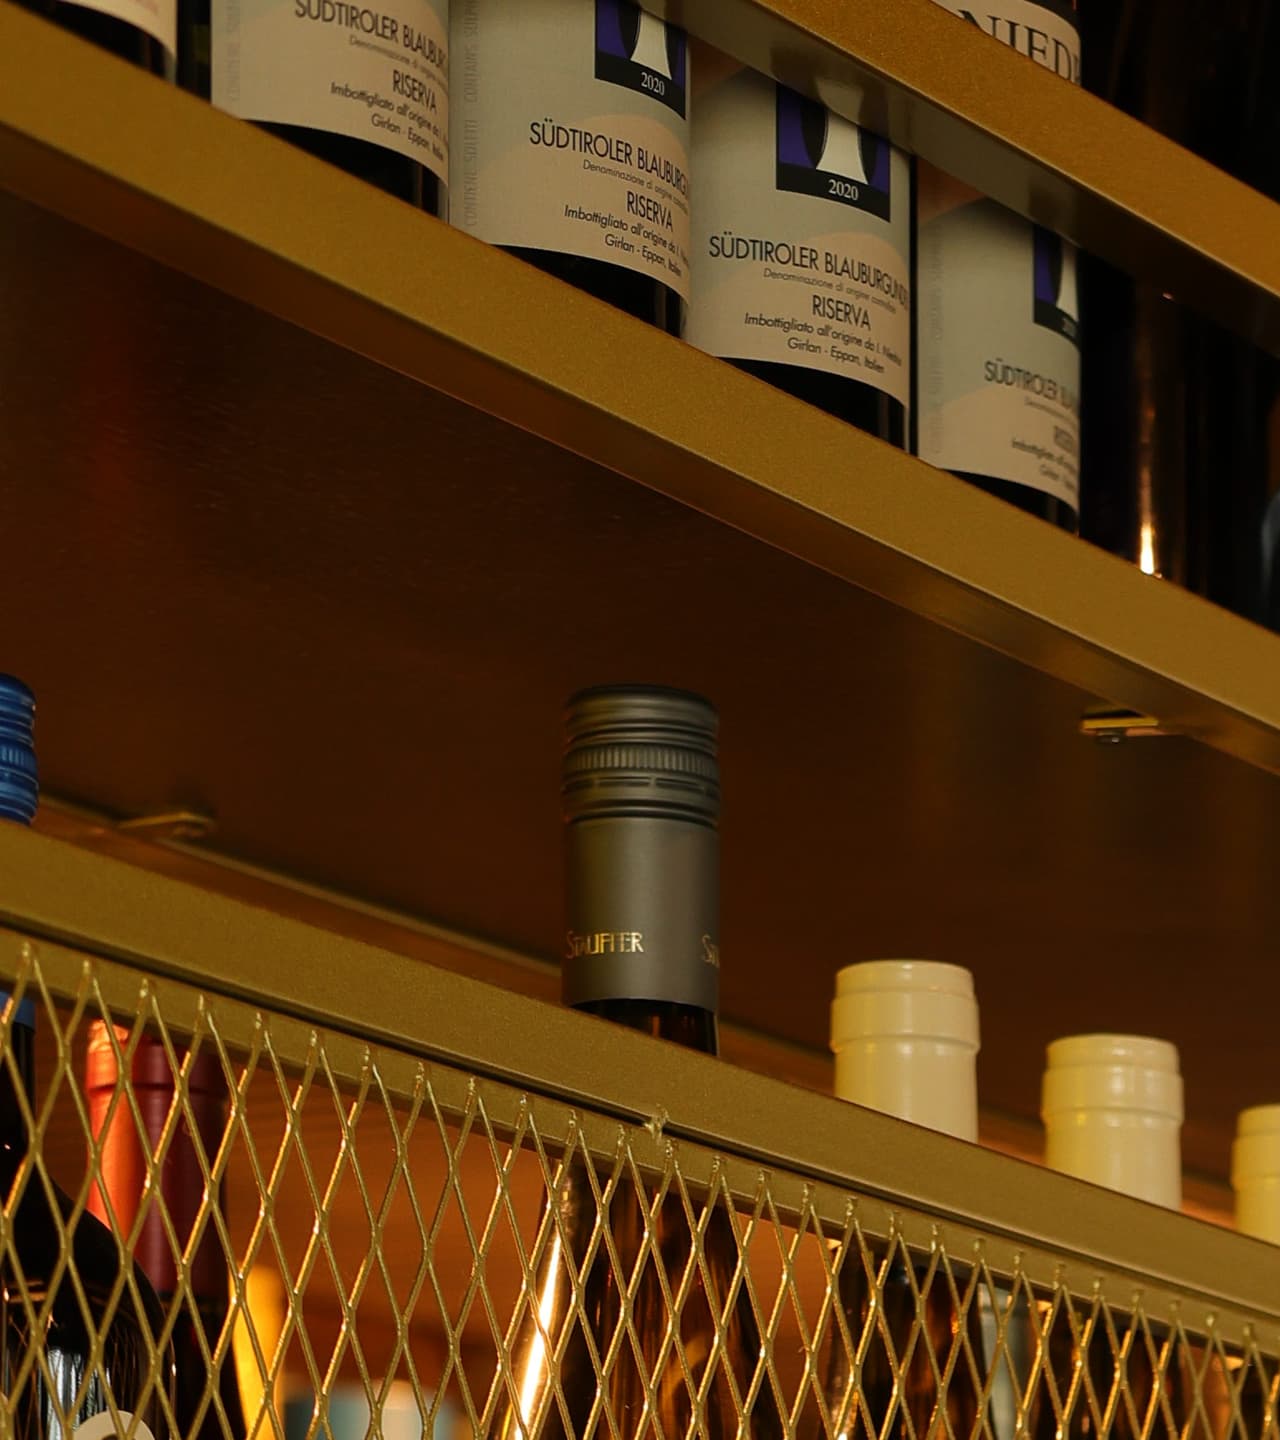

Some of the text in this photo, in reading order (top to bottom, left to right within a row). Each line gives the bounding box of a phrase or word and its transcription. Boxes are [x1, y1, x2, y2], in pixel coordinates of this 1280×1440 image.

[392, 69, 438, 114] RISERVA
[640, 71, 665, 97] 2020
[371, 113, 401, 134] Girlan
[529, 117, 633, 167] SÜDTIROLER
[828, 178, 859, 201] 2020
[563, 204, 629, 234] Imbottigliato
[626, 189, 674, 233] RISERVA
[604, 234, 635, 255] Girlan
[708, 231, 820, 271] SÜDTIROLER
[744, 311, 815, 335] Imbottigliato
[811, 294, 872, 332] RISERVA
[787, 336, 822, 355] Girlan
